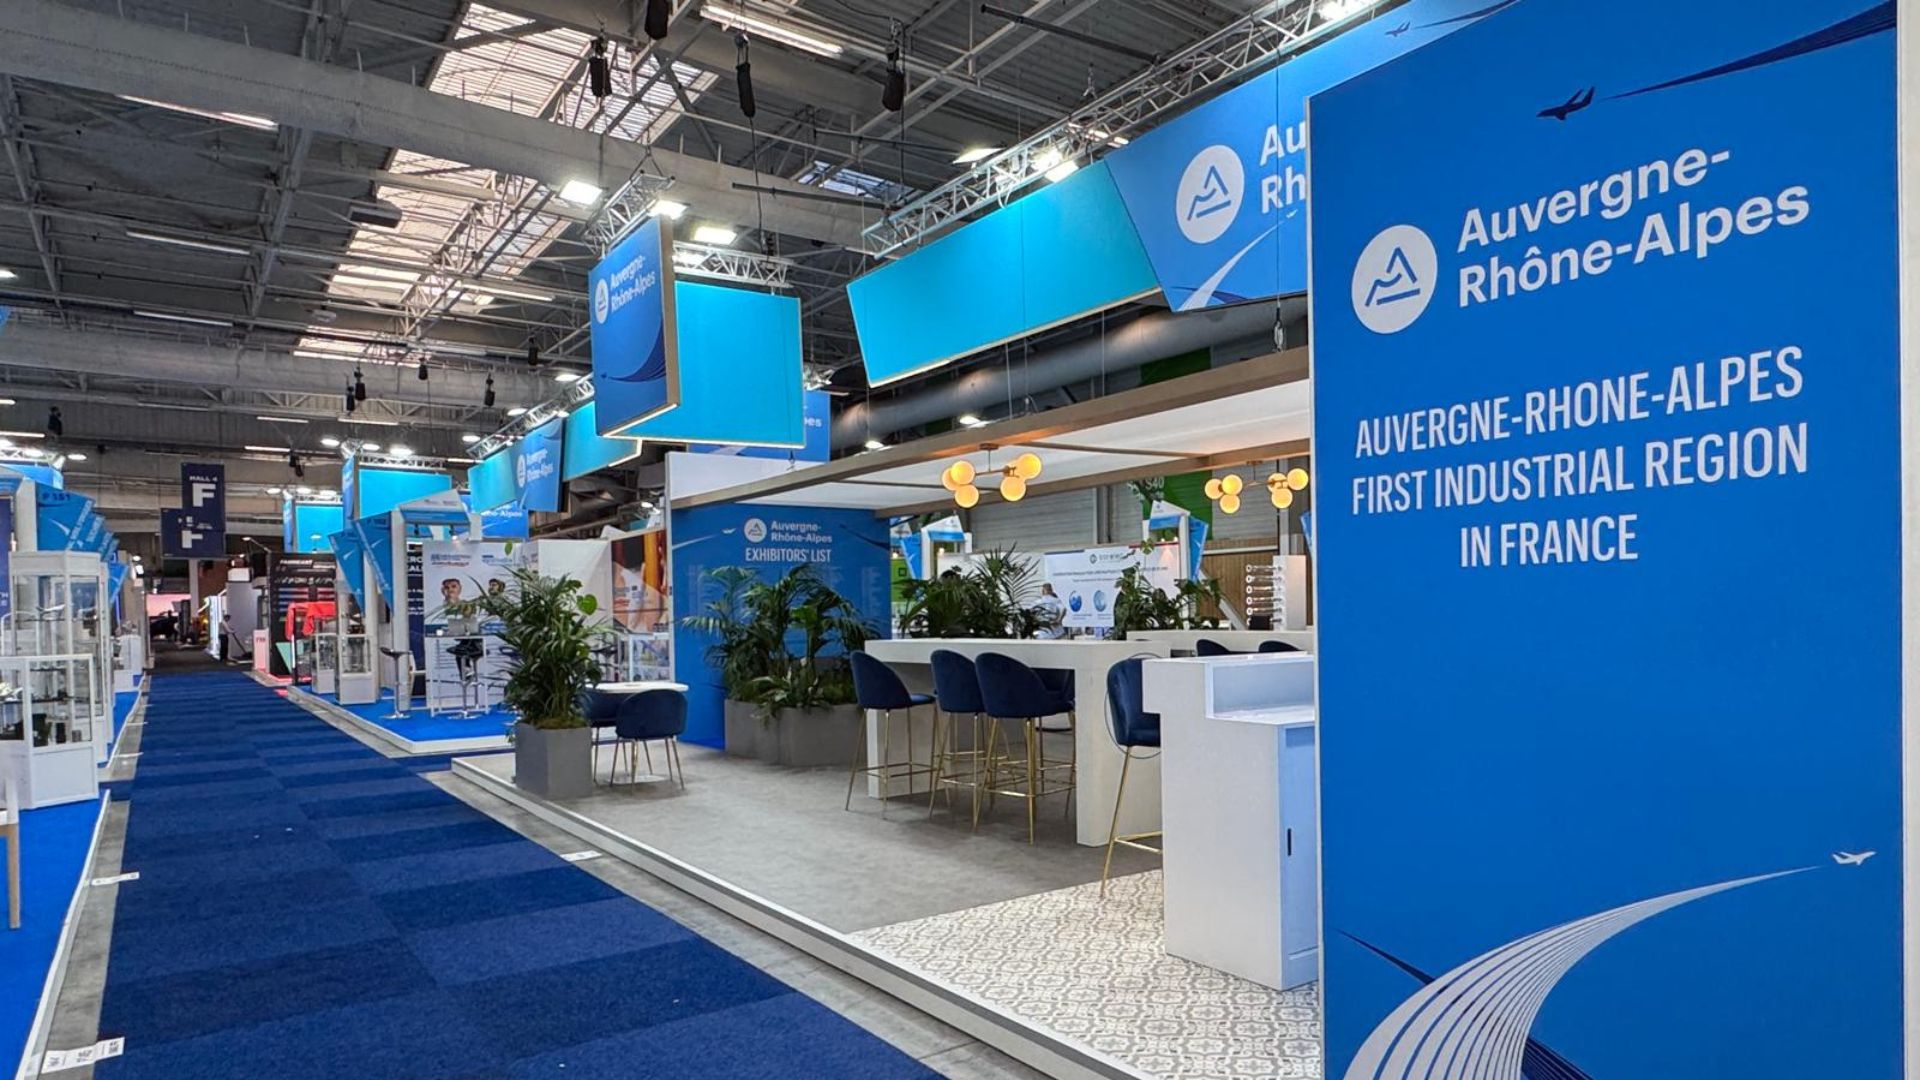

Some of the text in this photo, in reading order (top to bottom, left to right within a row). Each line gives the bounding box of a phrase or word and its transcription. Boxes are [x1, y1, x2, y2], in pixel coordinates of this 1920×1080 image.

[1260, 121, 1306, 167] Au
[1261, 165, 1306, 214] Rh
[1457, 149, 1730, 252] Auvergne-
[1459, 186, 1809, 307] Rhône-Alpes
[610, 255, 646, 290] Auvergne-
[611, 270, 656, 313] Rhône-Alpes
[1355, 346, 1803, 458] AUVERGNE-RHONE-ALPES
[1352, 422, 1808, 515] FIRST INDUSTRIAL REGION
[192, 483, 217, 507] F
[770, 520, 822, 533] Auvergne-
[770, 532, 833, 544] Rhône-Alpes
[1461, 514, 1639, 567] IN FRANCE
[745, 547, 833, 563] EXHIBITORS' LIST
